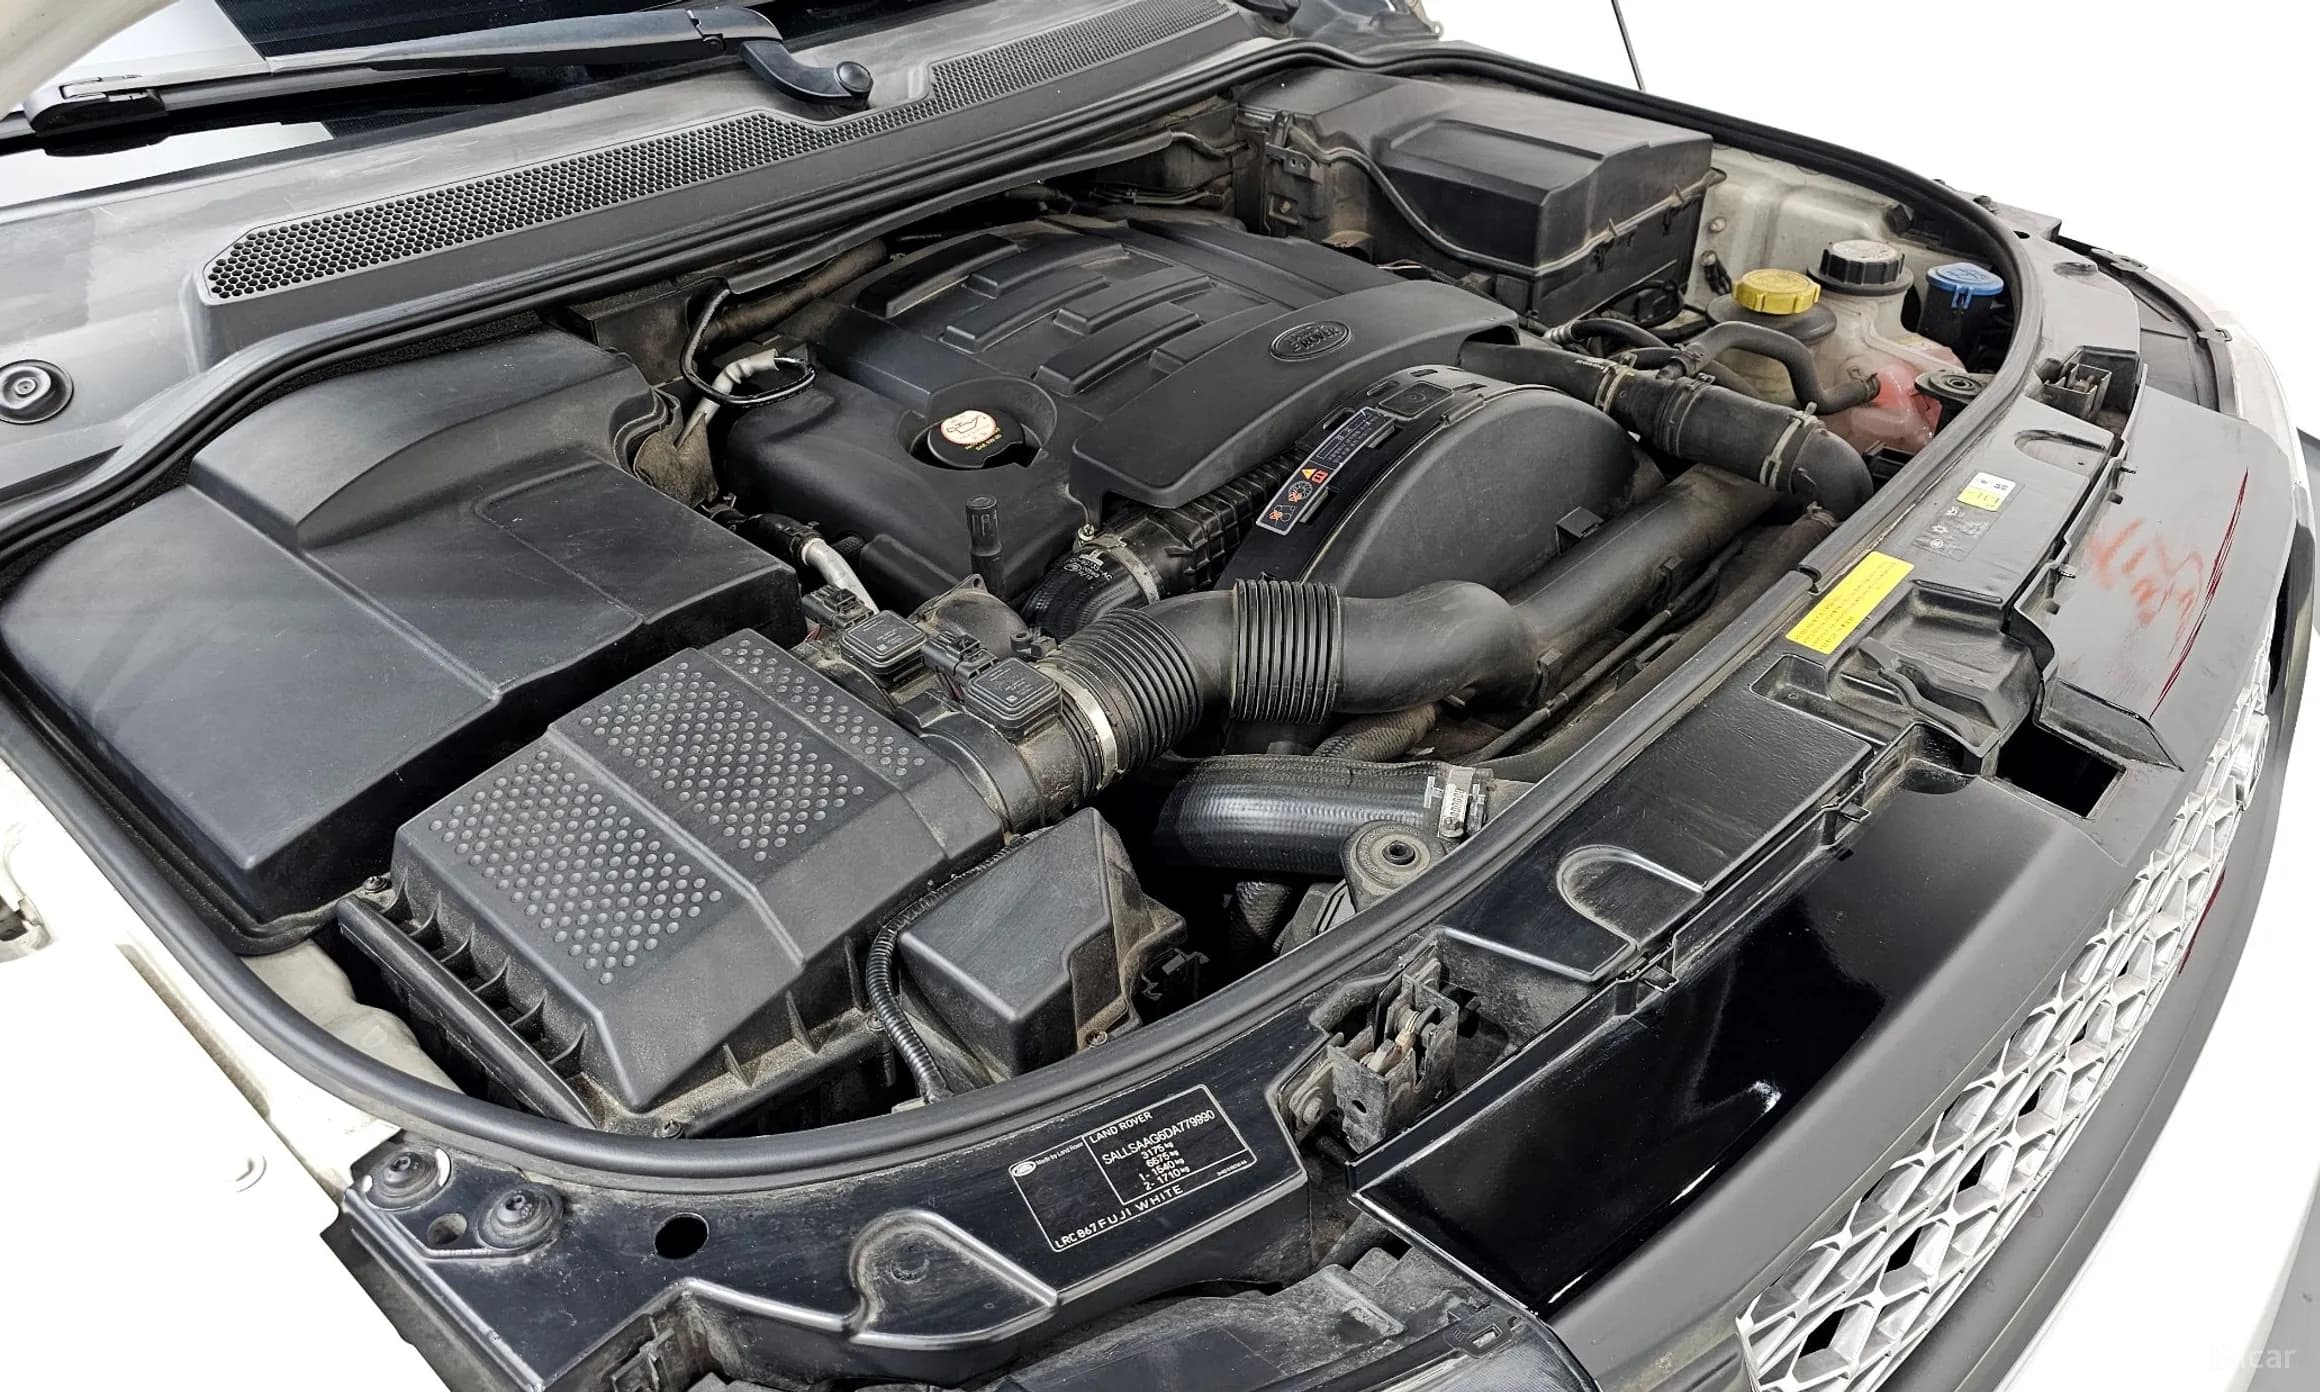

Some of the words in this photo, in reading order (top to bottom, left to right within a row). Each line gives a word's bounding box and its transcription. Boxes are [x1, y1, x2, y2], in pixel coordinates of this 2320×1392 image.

[1300, 327, 1341, 349] ROVER
[1089, 1125, 1119, 1144] LAND
[1118, 1111, 1153, 1131] ROVER
[1140, 1143, 1165, 1160] 3175
[1145, 1151, 1170, 1167] 6675
[1151, 1160, 1176, 1176] 1540
[1157, 1168, 1181, 1184] 1710
[1054, 1232, 1078, 1249] LRC
[1076, 1222, 1098, 1239] 867
[1097, 1207, 1132, 1229] FUJI
[1134, 1184, 1184, 1212] WHITE
